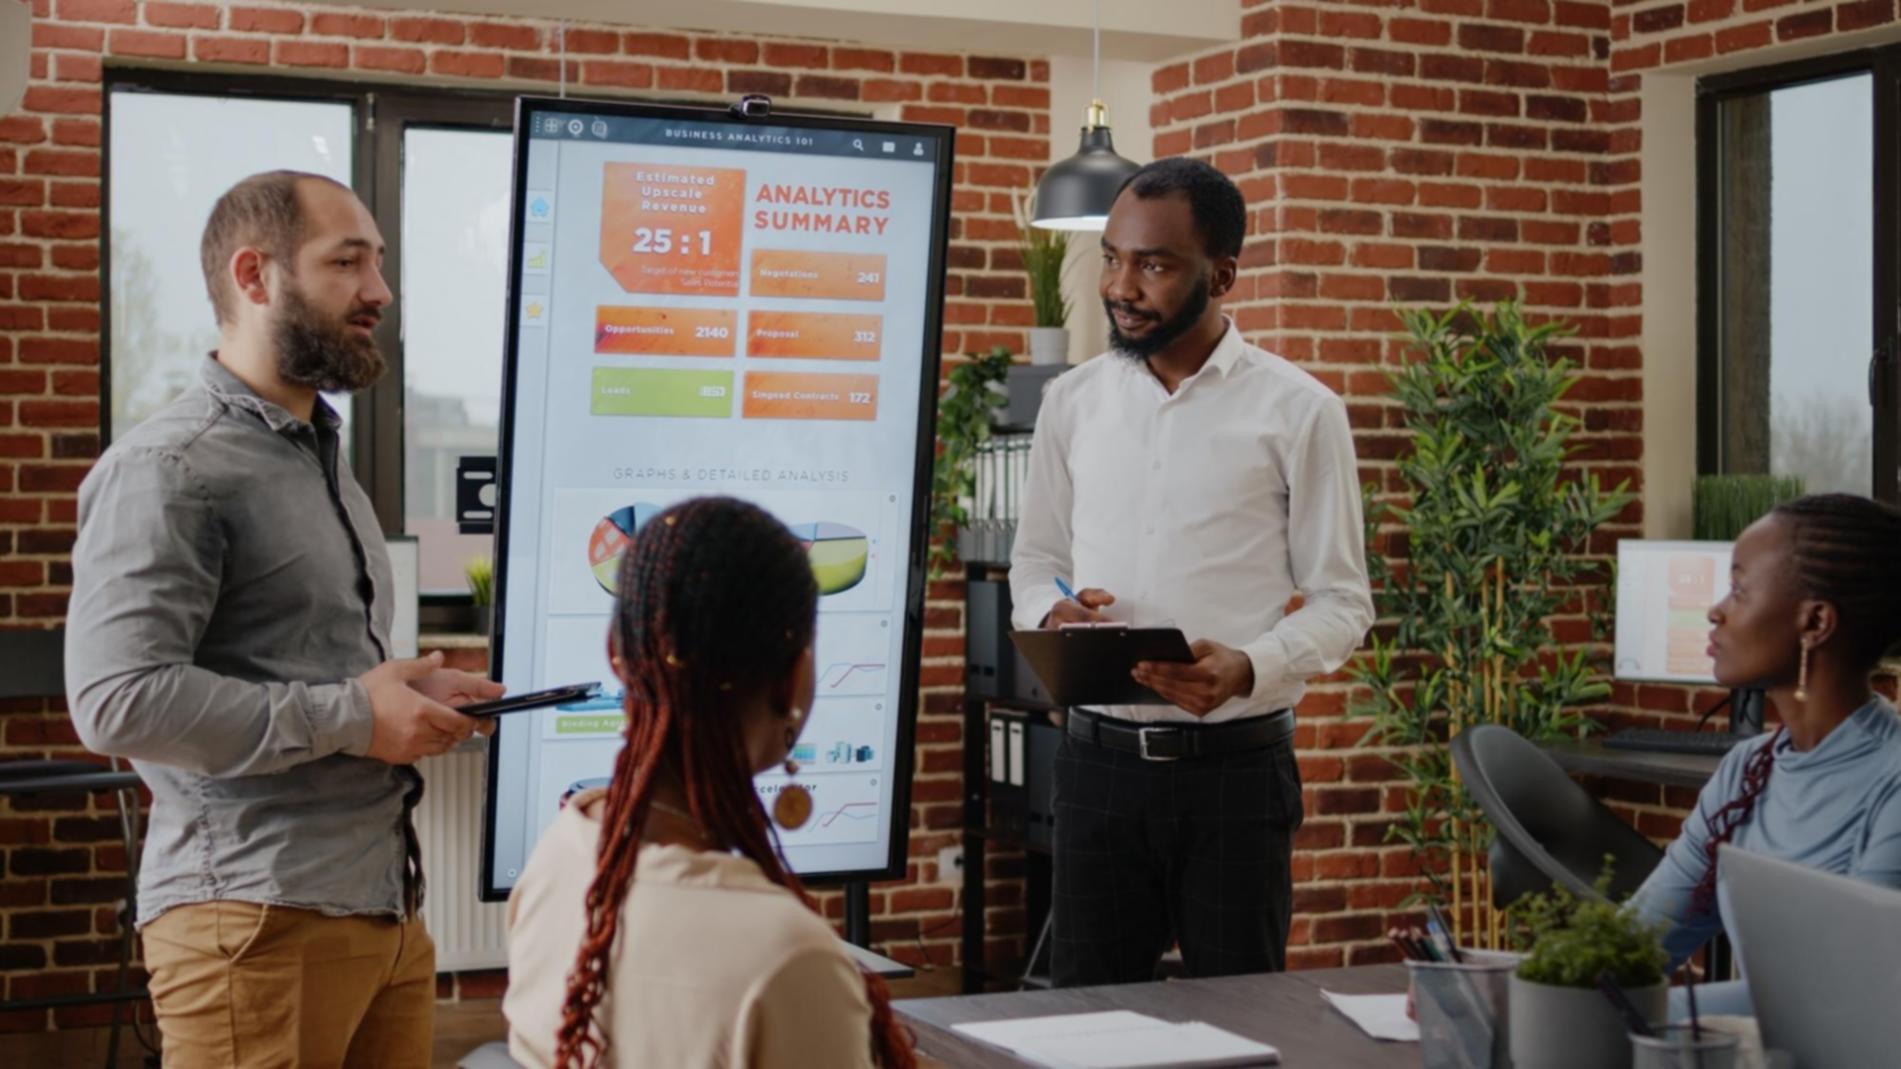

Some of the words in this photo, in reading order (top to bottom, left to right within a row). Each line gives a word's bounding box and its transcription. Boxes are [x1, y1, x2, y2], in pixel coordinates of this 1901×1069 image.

[665, 129, 723, 141] BUSINESS
[728, 133, 791, 145] ANALYTICS
[635, 171, 715, 185] Estimated
[641, 186, 703, 199] Upscale
[756, 183, 890, 209] ANALYTICS
[641, 200, 706, 213] Revenue
[754, 210, 889, 235] SUMMARY
[633, 227, 672, 253] 25
[698, 230, 711, 255] 1
[857, 272, 879, 284] 241
[604, 324, 674, 336] Opportunities
[695, 326, 728, 338] 2140
[756, 329, 800, 340] Proposal
[854, 331, 875, 342] 312
[794, 391, 839, 400] Contracts
[849, 392, 871, 403] 172
[612, 467, 676, 480] GRAPHS
[681, 469, 691, 480] &
[697, 468, 771, 481] DETAILED
[777, 470, 849, 482] ANALYSIS
